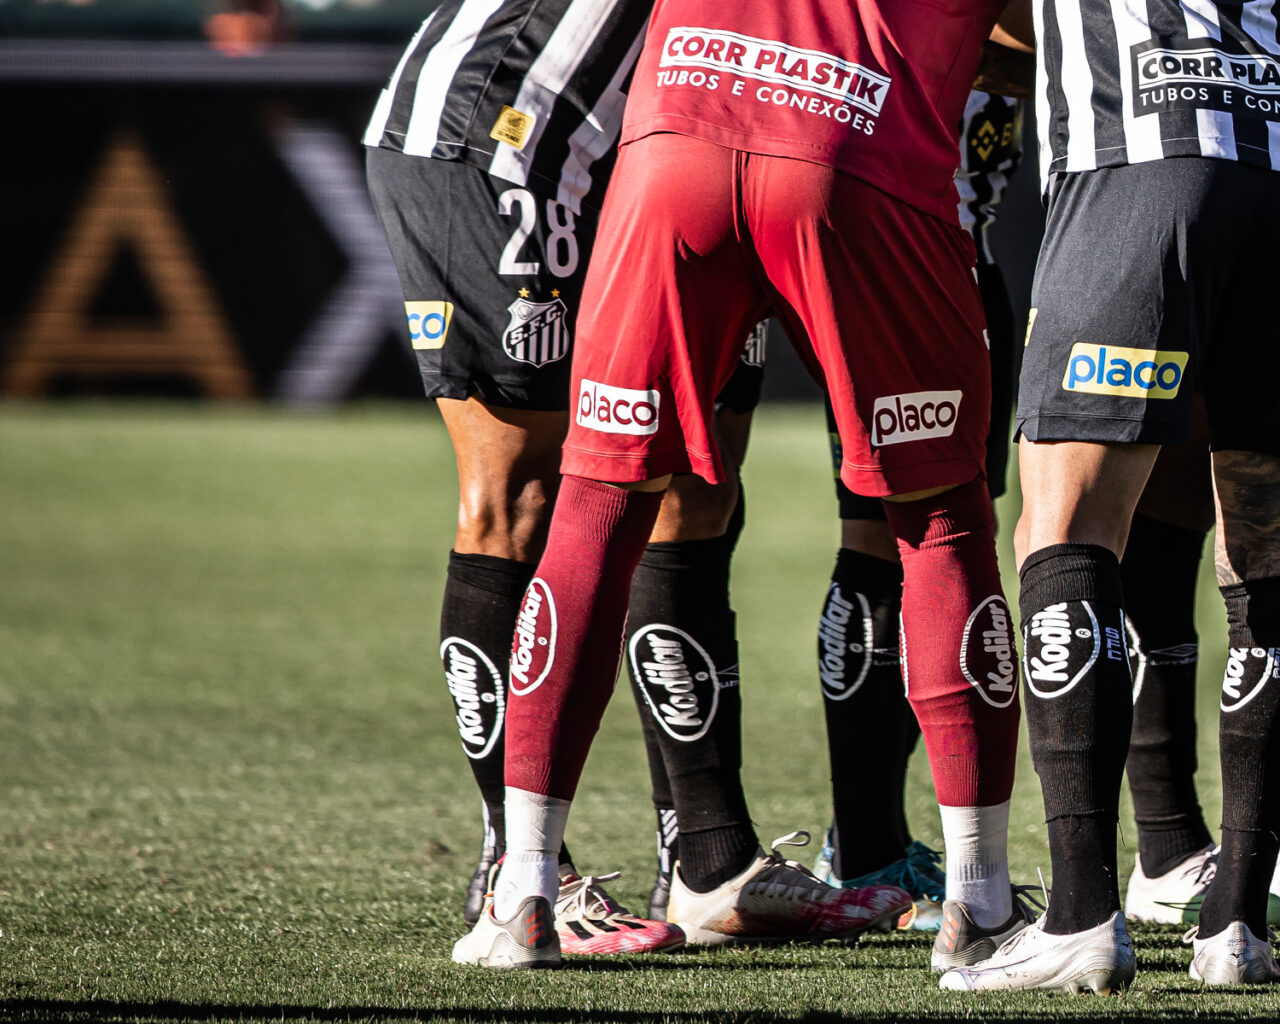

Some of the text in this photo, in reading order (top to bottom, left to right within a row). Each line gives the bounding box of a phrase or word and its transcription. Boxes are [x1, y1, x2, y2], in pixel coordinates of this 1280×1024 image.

[656, 70, 876, 136] TUBOS E CONEXÕES
[668, 36, 885, 107] CORR PLASTIK
[1139, 86, 1210, 107] TUBOS
[1223, 90, 1233, 104] E
[1142, 55, 1225, 80] CORR
[498, 188, 579, 278] 28
[1068, 347, 1182, 391] placo
[580, 385, 657, 427] placo
[875, 397, 957, 444] placo
[511, 583, 543, 684] Kodilar
[819, 582, 855, 690] Kodilar
[982, 602, 1015, 693] Kodilar
[446, 645, 486, 745] Kodilar
[641, 633, 703, 726] Kodilar
